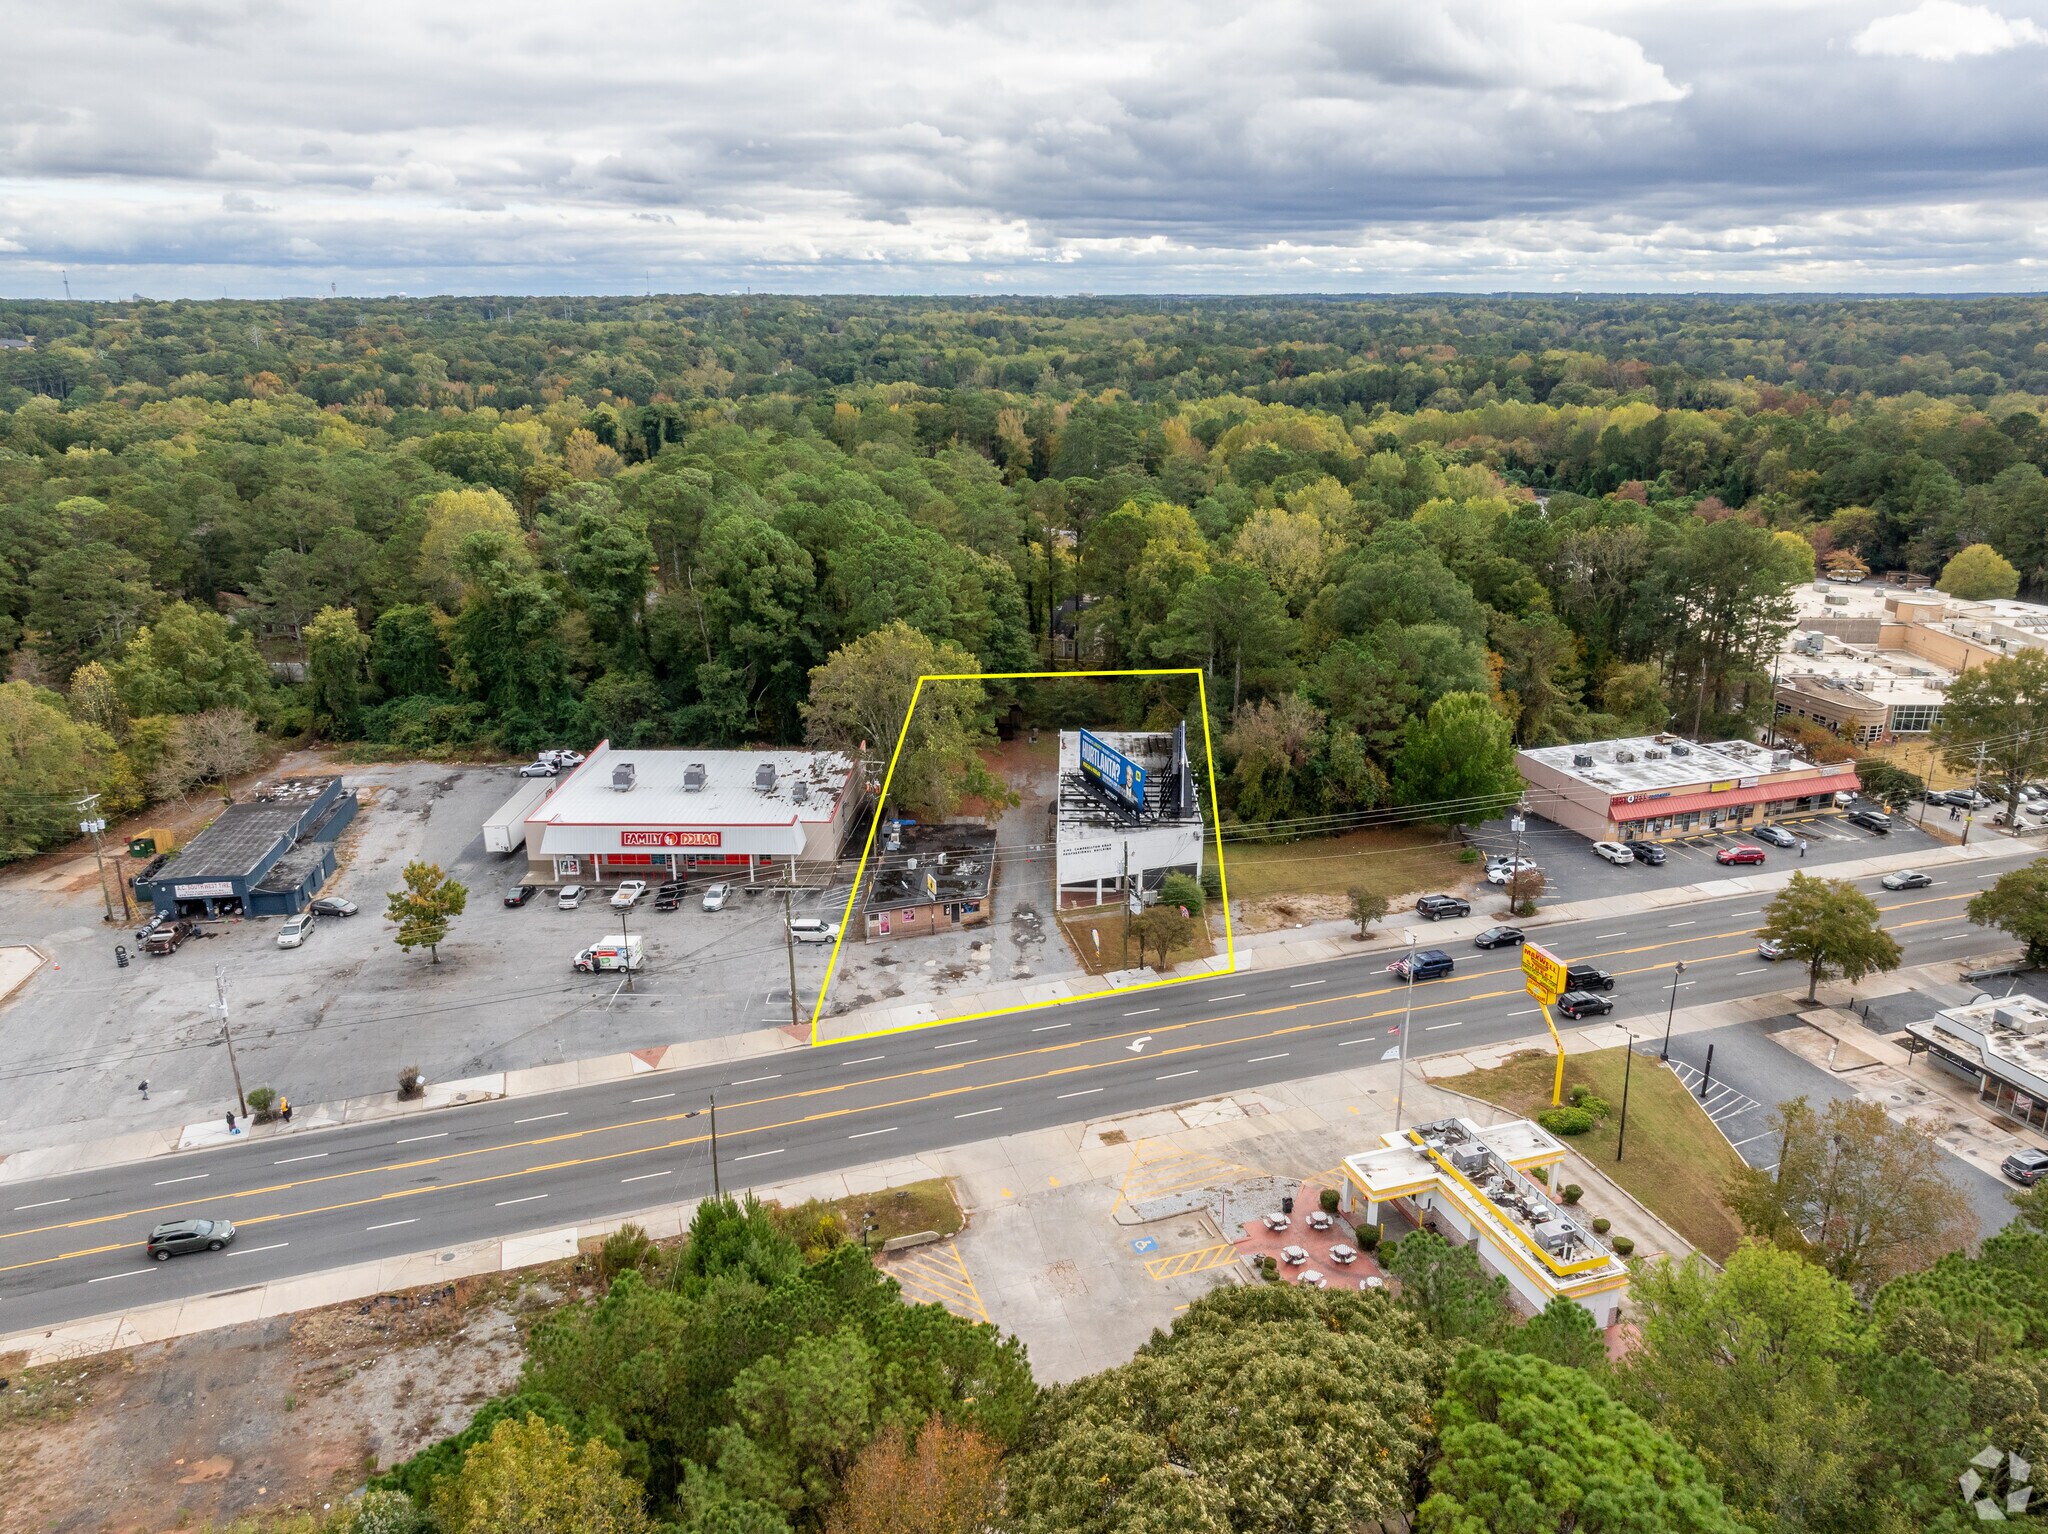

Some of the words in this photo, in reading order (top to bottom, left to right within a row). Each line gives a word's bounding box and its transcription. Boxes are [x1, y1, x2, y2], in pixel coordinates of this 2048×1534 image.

[624, 832, 663, 844] FAMILY
[680, 833, 718, 845] DOLLAR
[1524, 948, 1557, 974] MAXWELL
[1526, 960, 1553, 980] STREET
